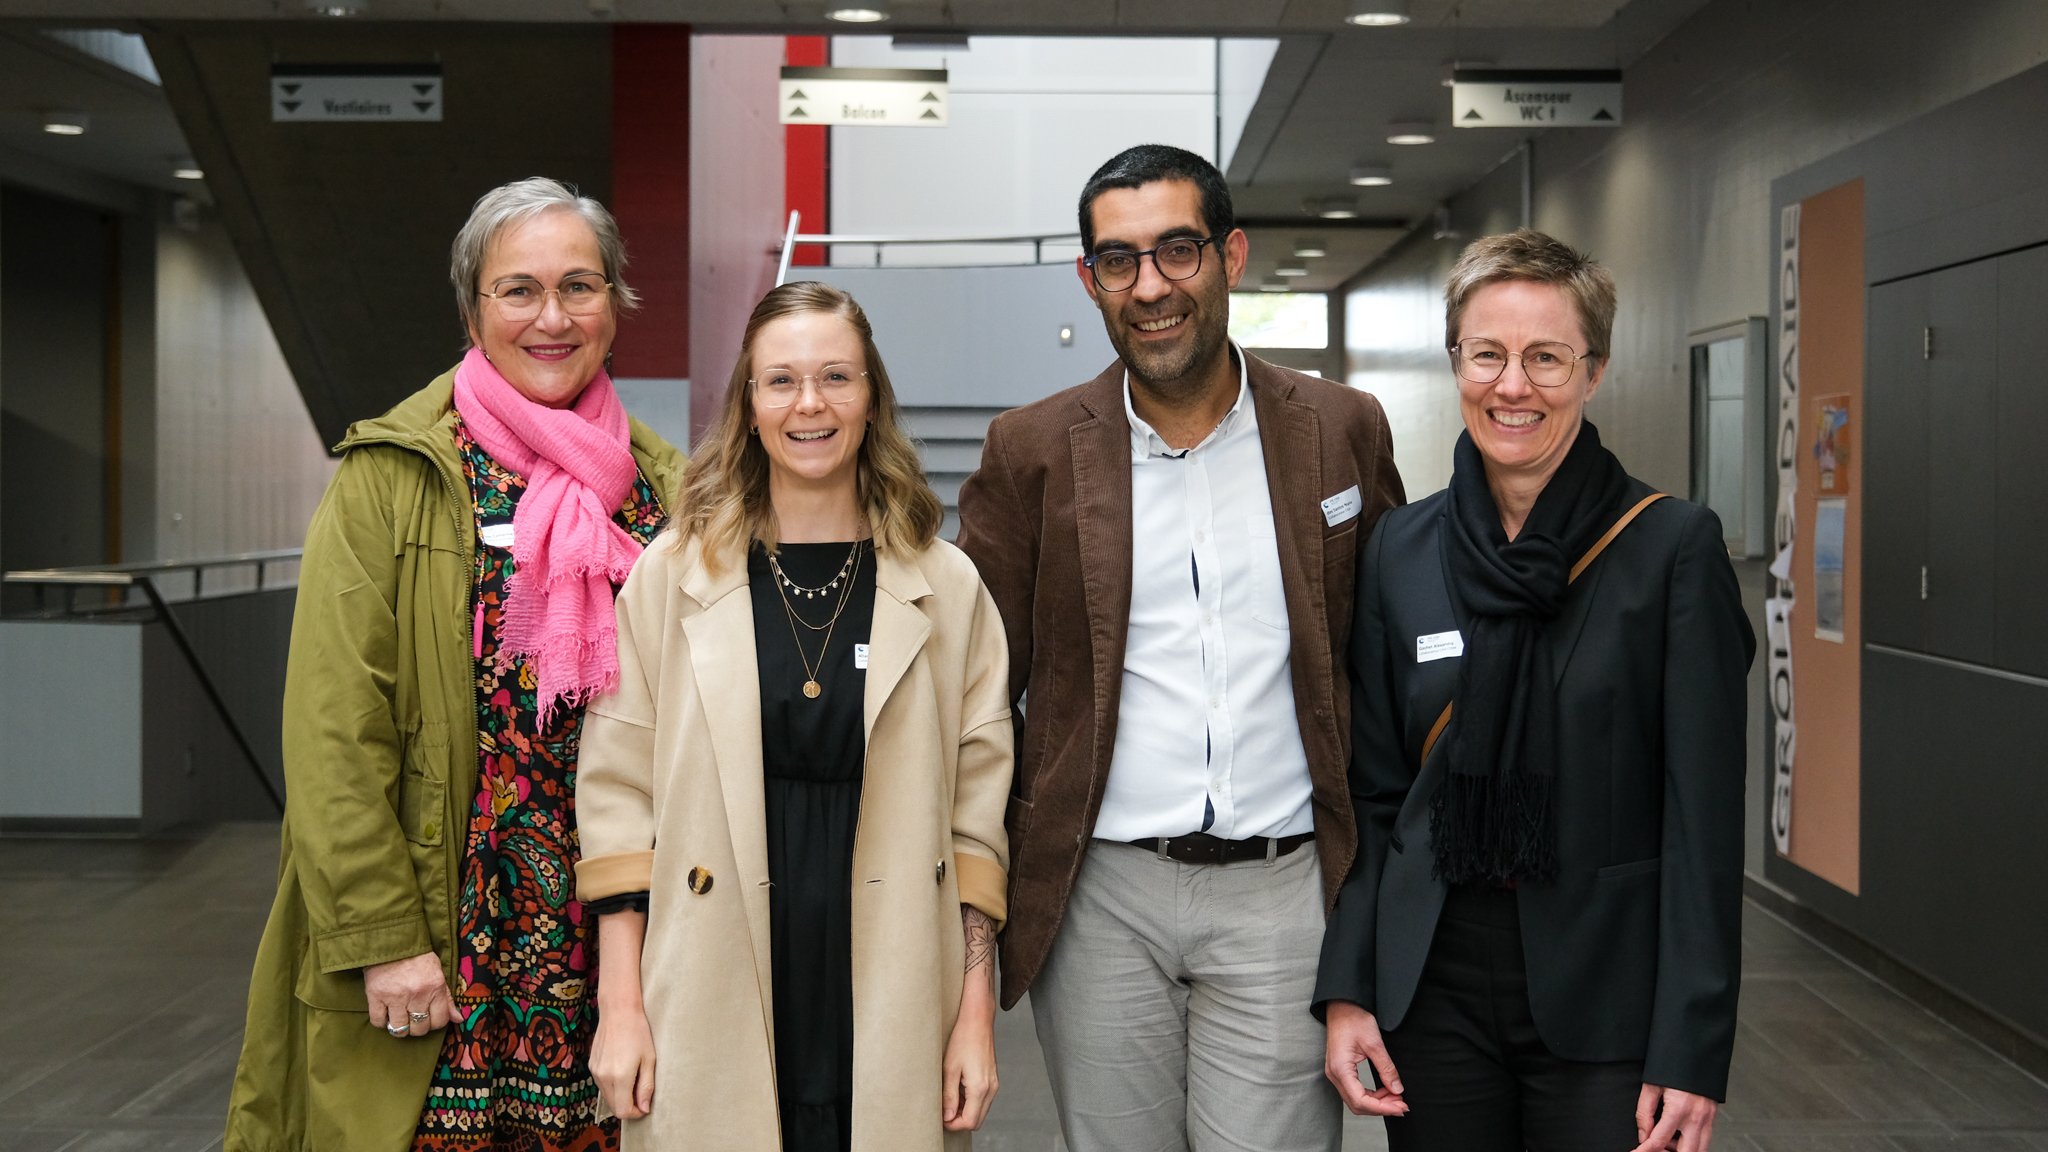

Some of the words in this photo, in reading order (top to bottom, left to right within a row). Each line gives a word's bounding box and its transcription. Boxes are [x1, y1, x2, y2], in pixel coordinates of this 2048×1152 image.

[1504, 88, 1571, 104] Ascenseur
[323, 99, 392, 115] Vestiaires
[842, 104, 887, 119] Balcon
[1520, 106, 1543, 121] WC
[1781, 208, 1798, 469] D'AIDE
